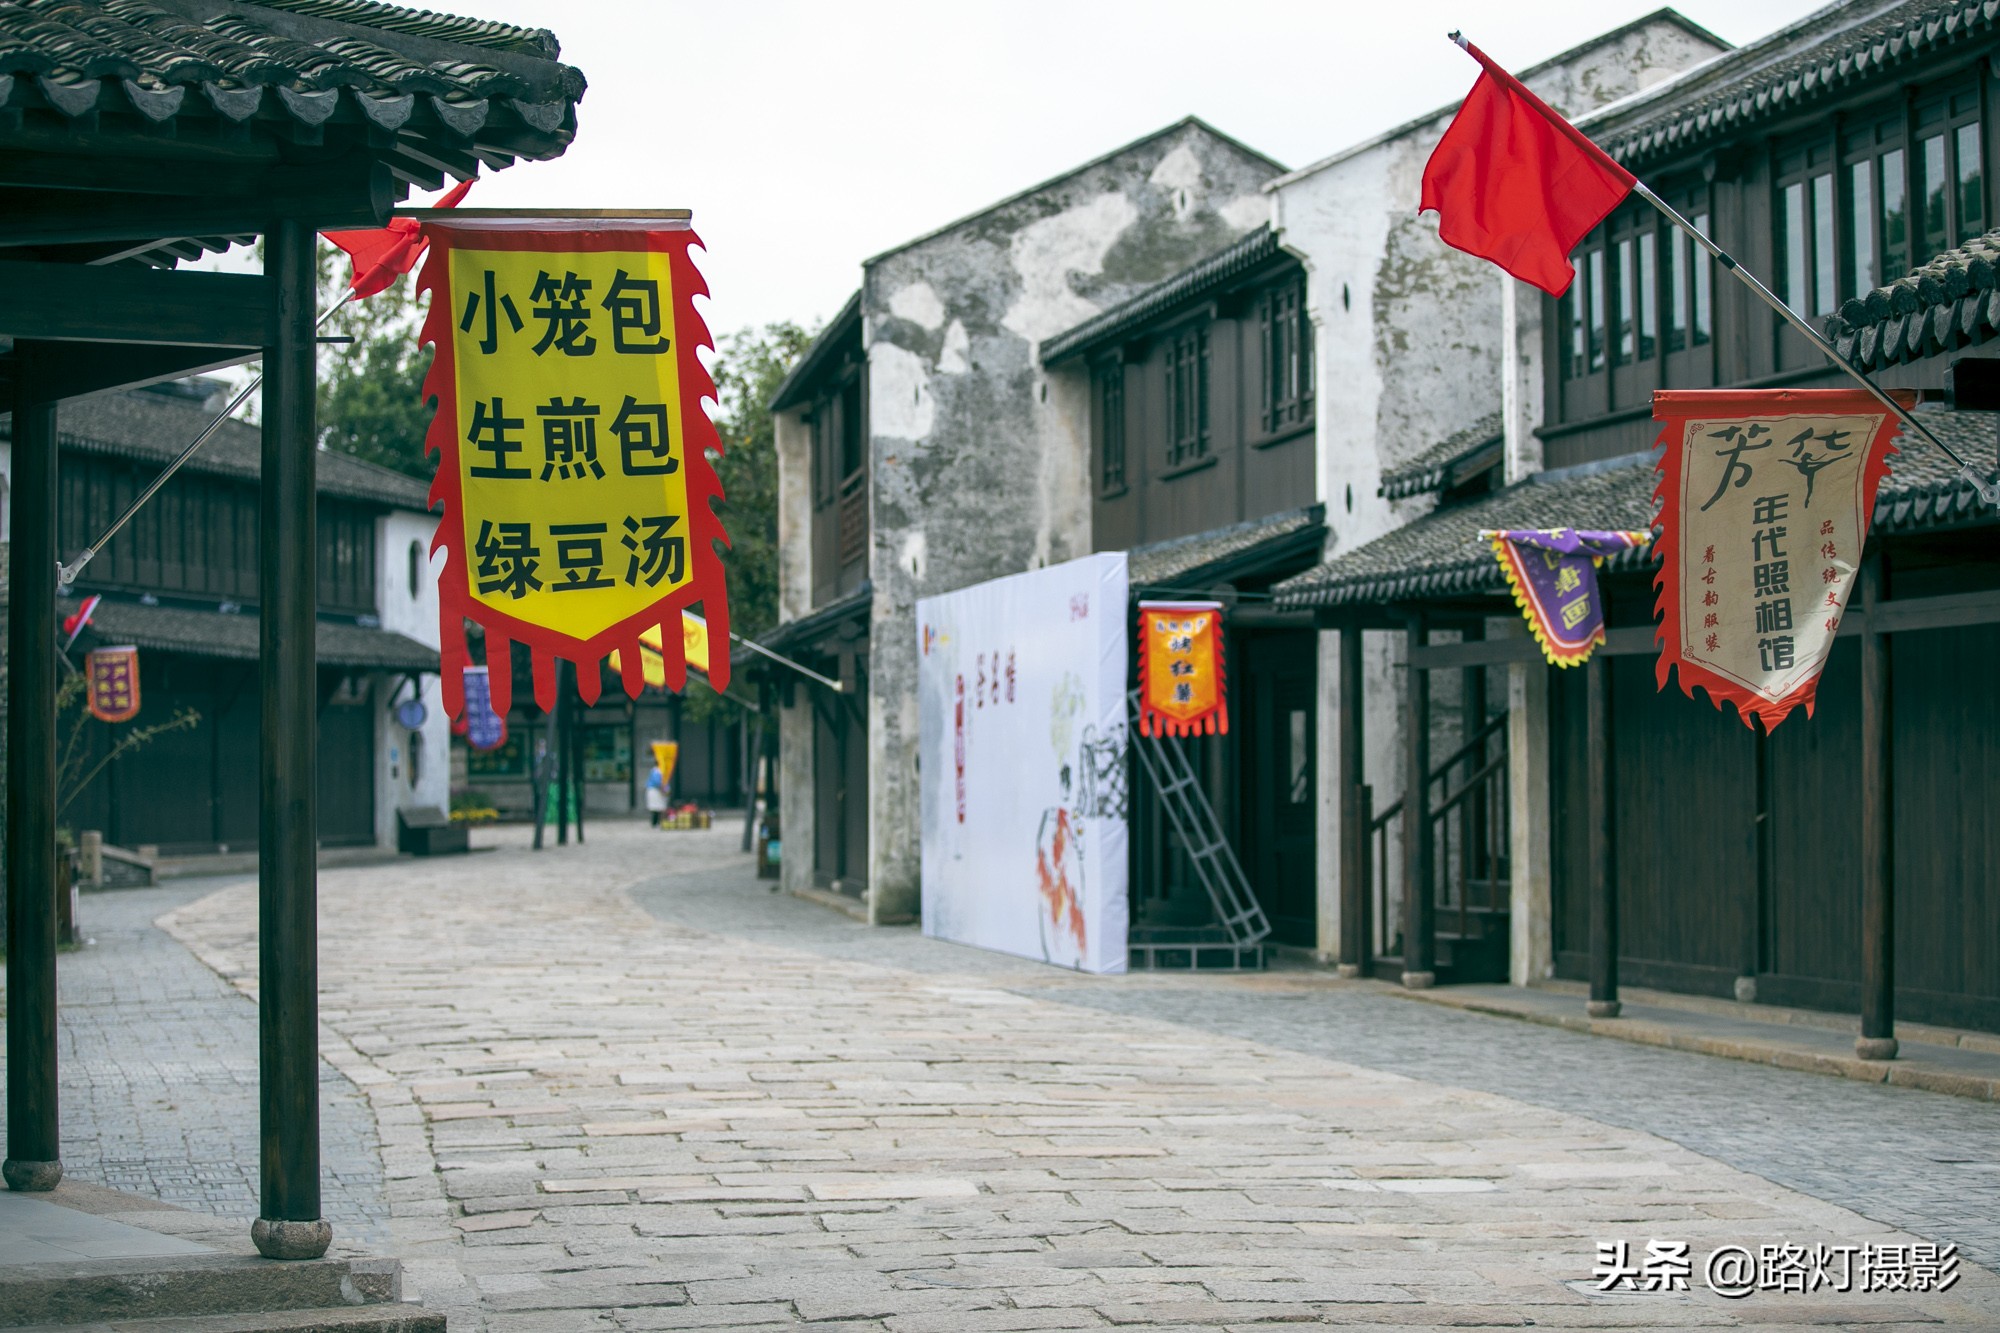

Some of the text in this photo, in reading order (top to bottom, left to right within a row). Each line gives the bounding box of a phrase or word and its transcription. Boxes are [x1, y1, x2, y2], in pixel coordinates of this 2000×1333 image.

[460, 269, 671, 357] 小笼包
[467, 395, 679, 483] 生煎包
[1700, 423, 1854, 512] 芳华
[474, 514, 686, 600] 绿豆汤
[1701, 544, 1721, 653] 着古韵服装
[1752, 493, 1795, 672] 年代照相馆
[1819, 519, 1842, 633] 品传统文化
